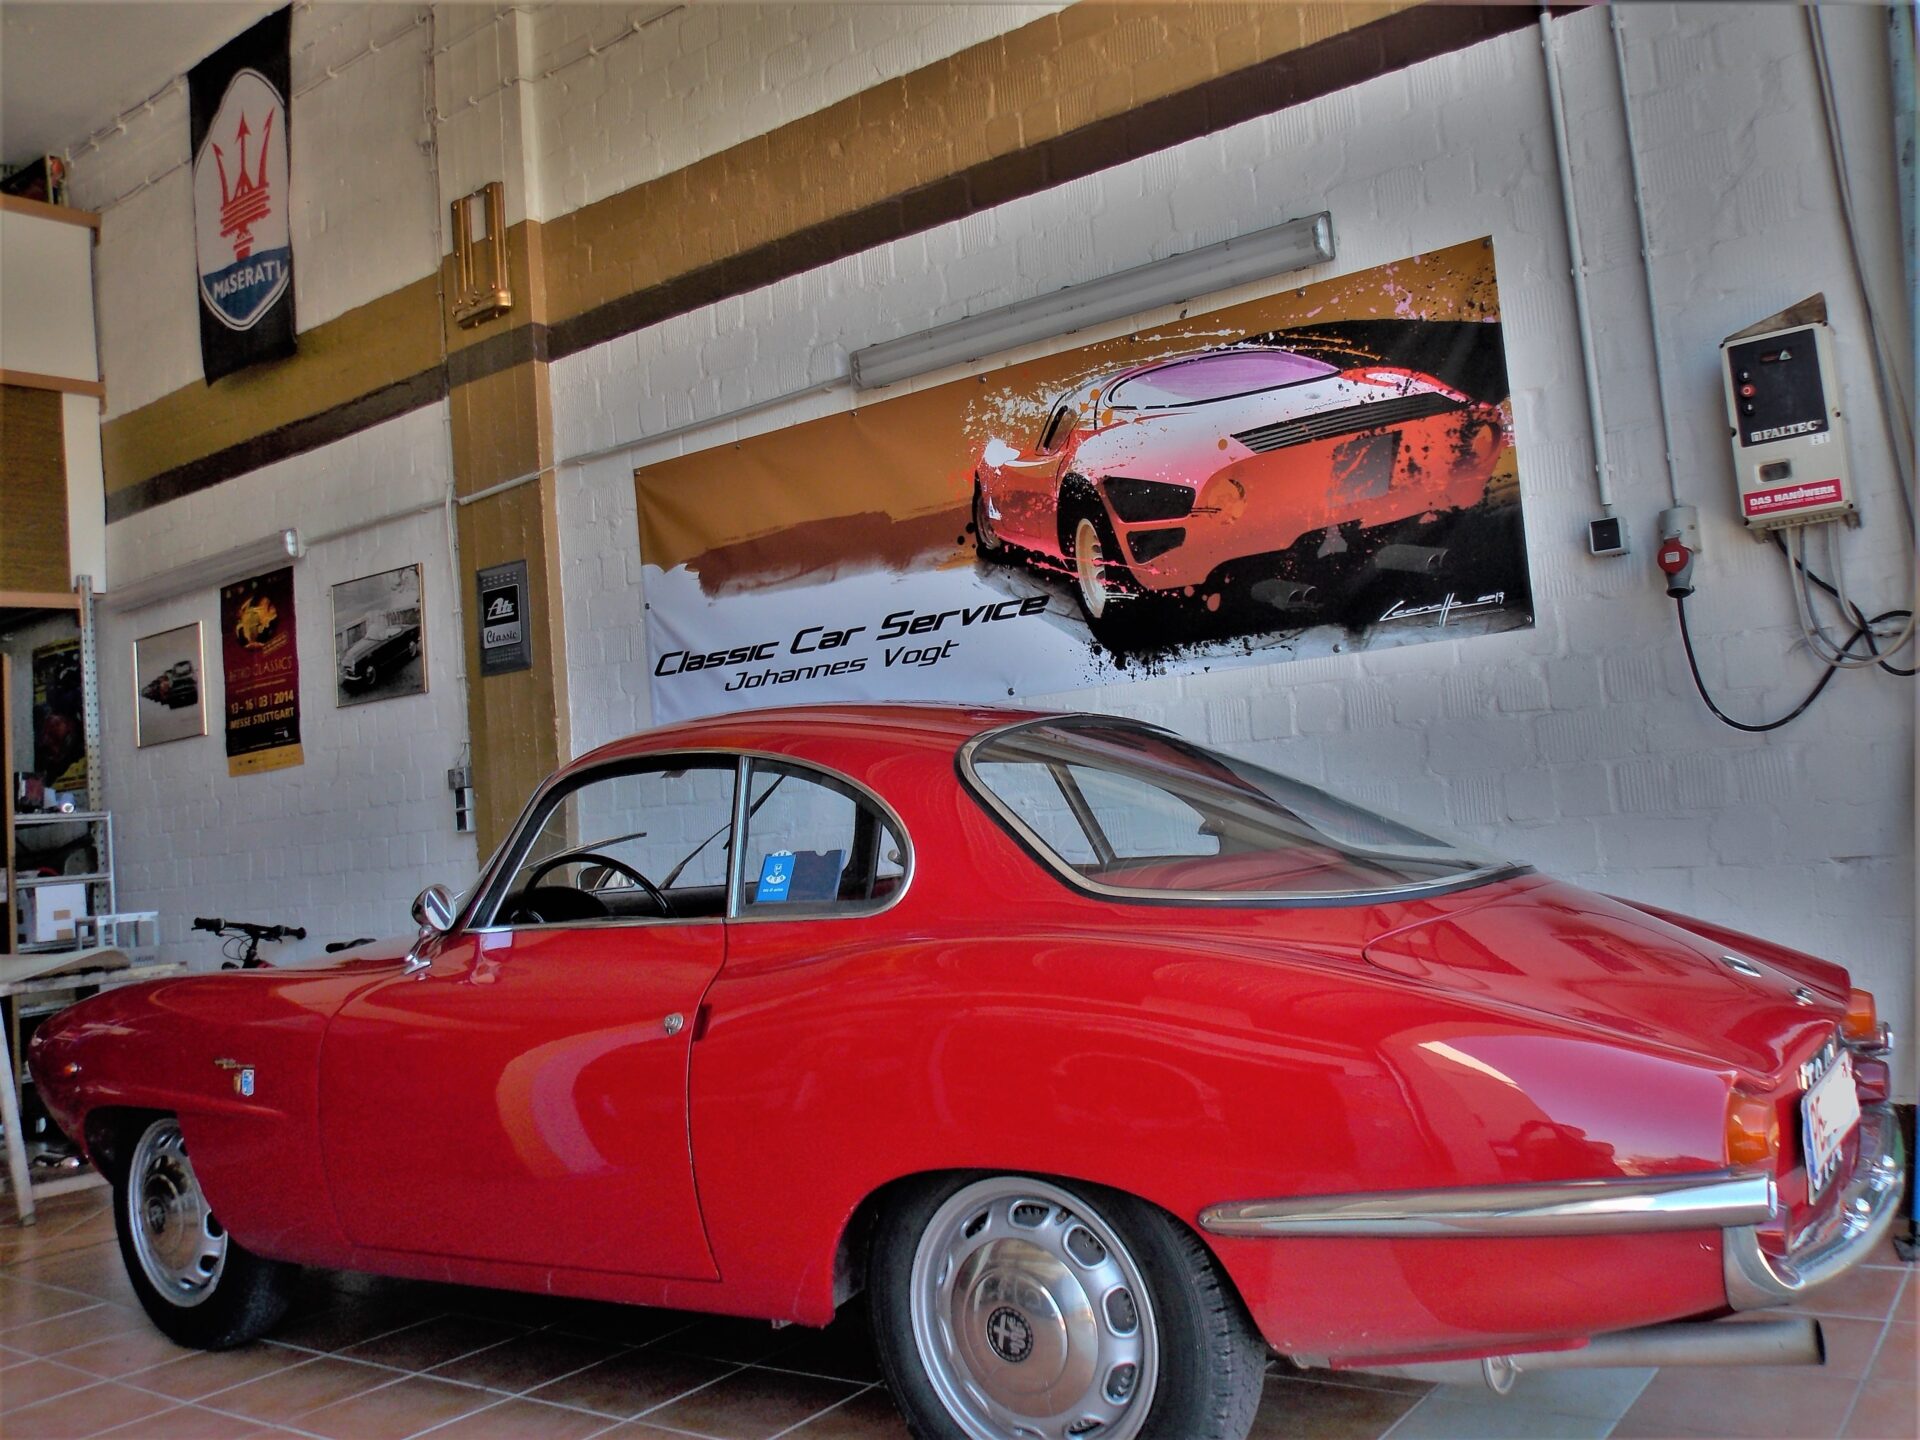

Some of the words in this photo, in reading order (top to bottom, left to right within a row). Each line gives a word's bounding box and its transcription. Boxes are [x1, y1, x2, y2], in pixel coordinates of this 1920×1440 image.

[212, 260, 282, 300] MASERATI
[1761, 420, 1817, 439] FALTEC
[1750, 496, 1771, 506] DAS
[1775, 486, 1835, 502] HANDWERK
[486, 630, 517, 644] Classic
[654, 641, 780, 677] Classic
[790, 625, 866, 655] Car
[876, 595, 1050, 641] Service
[724, 657, 869, 692] Johannes
[885, 640, 960, 668] Vogt
[274, 689, 294, 705] 2014
[253, 707, 294, 725] STUTTGART
